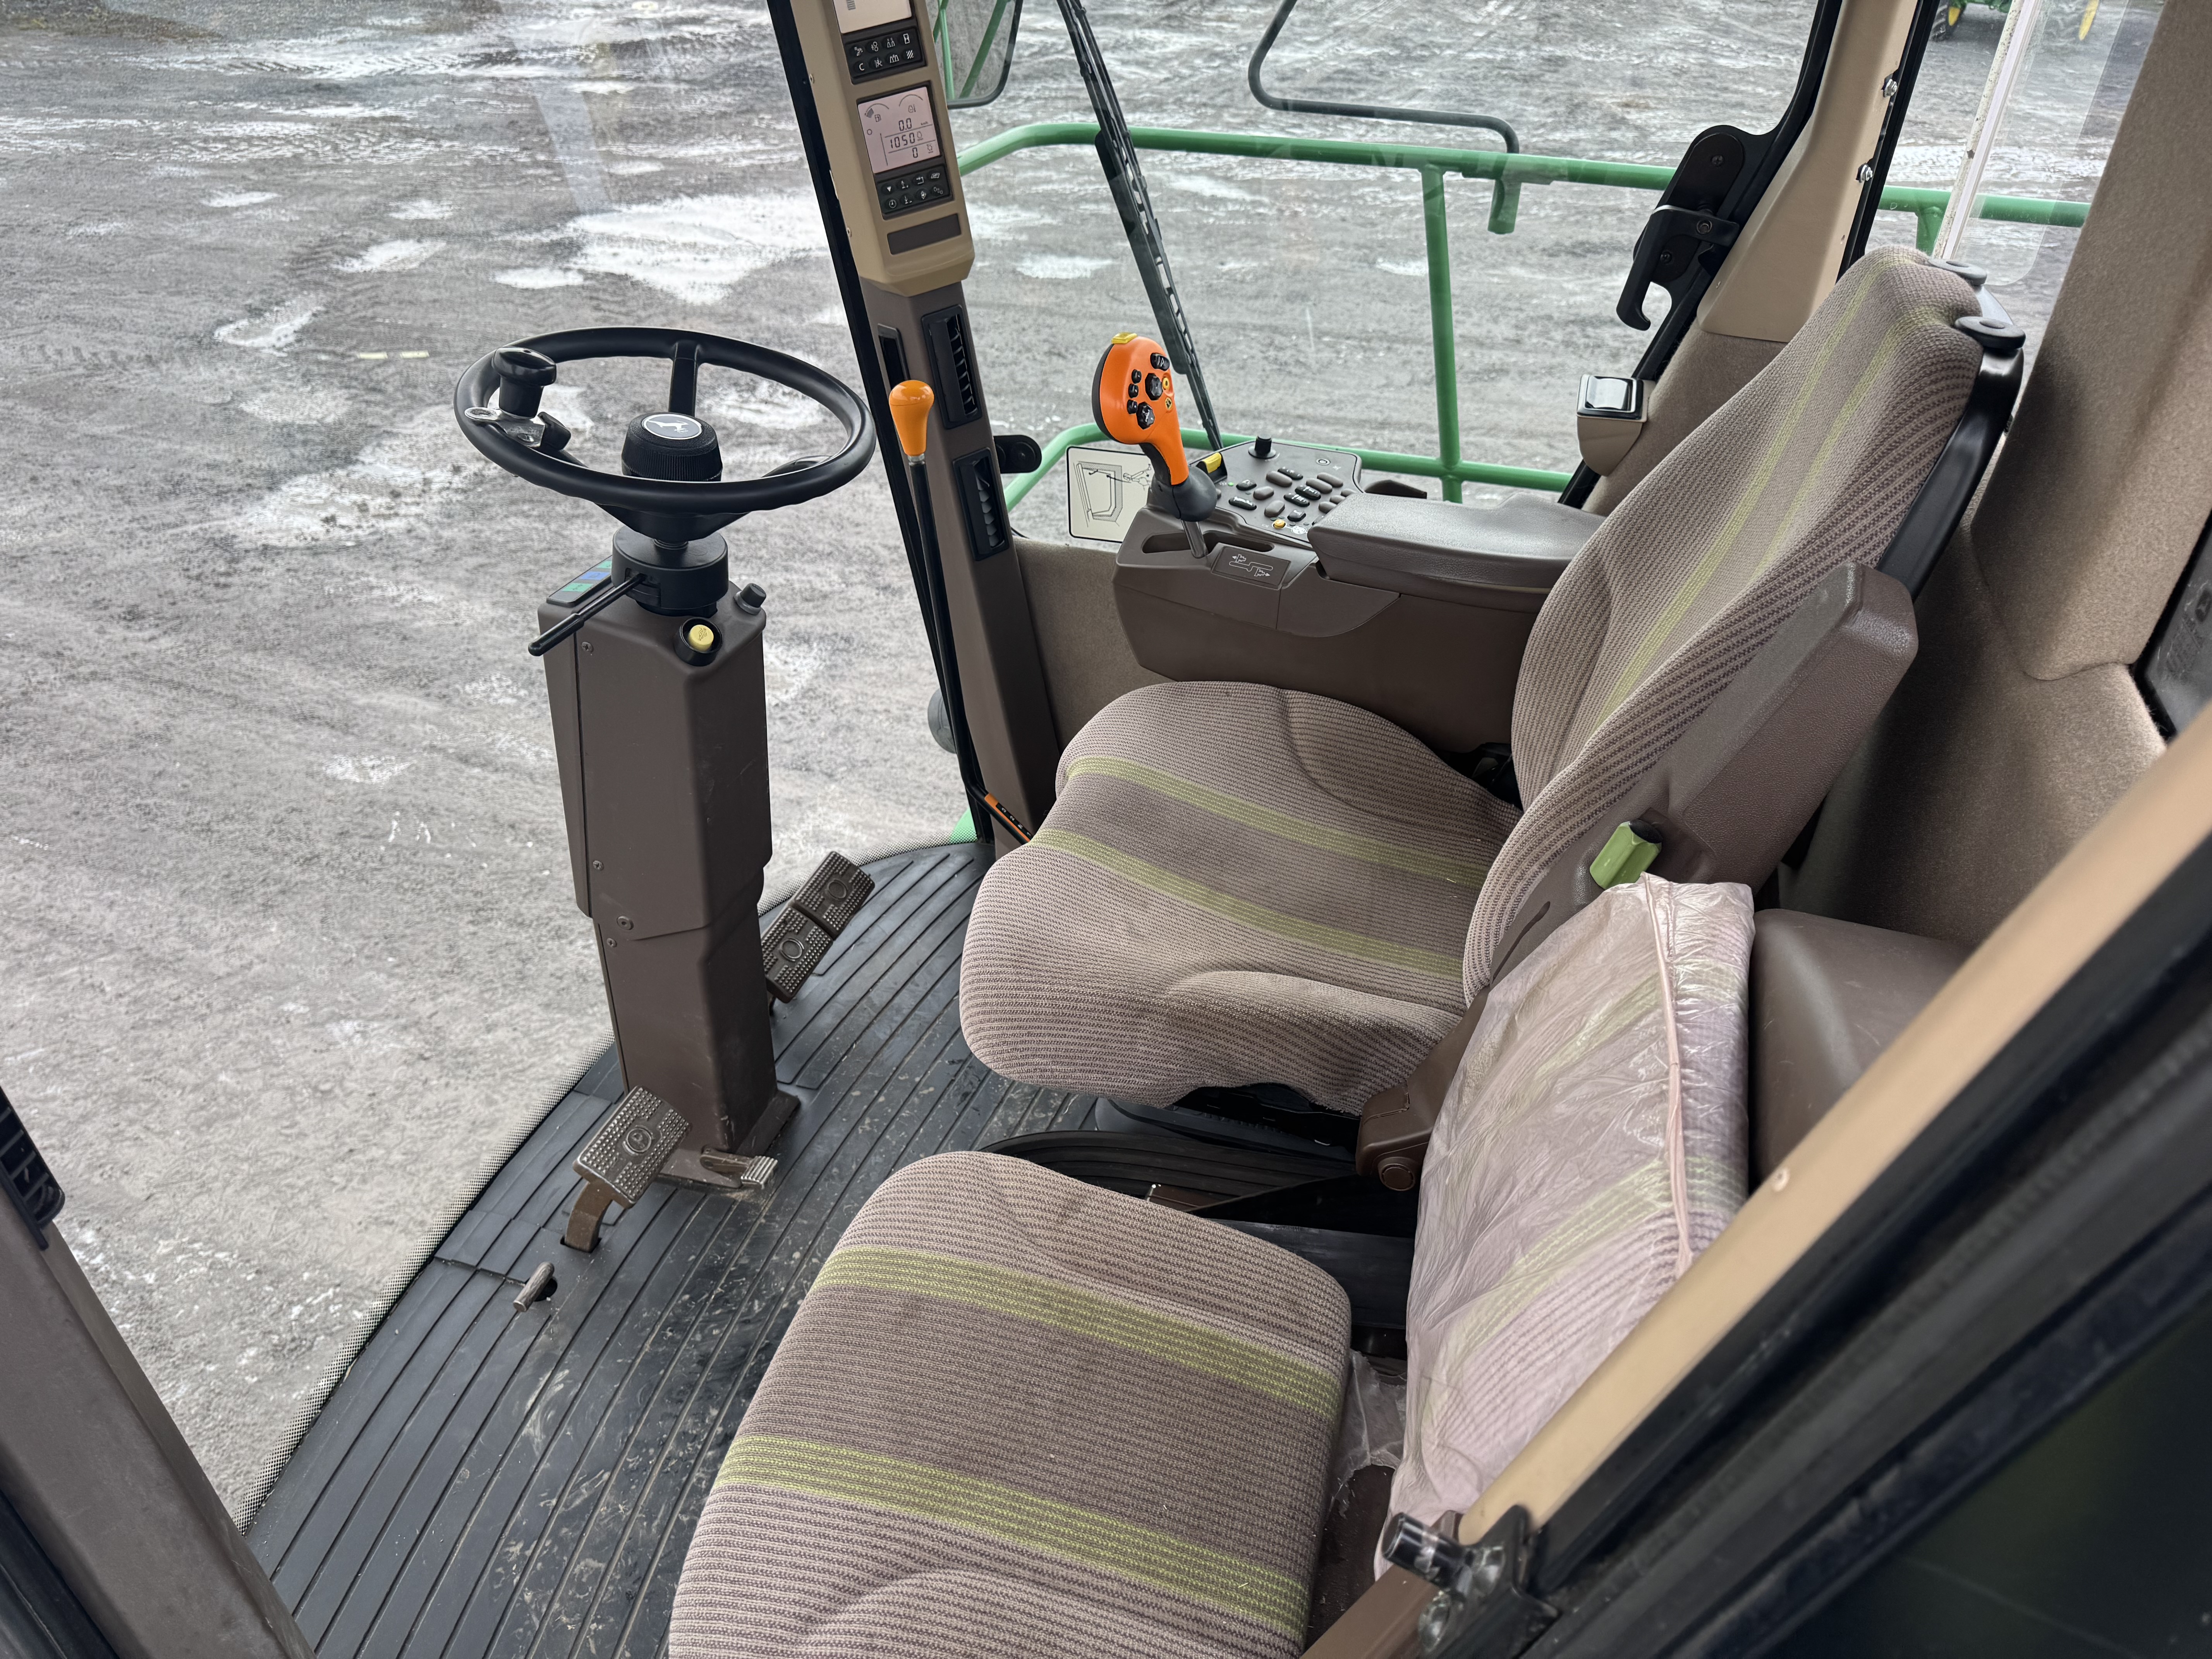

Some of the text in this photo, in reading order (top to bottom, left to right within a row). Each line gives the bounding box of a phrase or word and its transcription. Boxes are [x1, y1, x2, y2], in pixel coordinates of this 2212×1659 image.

[859, 63, 865, 71] C
[898, 118, 912, 131] 0.0
[890, 132, 915, 149] 1050
[912, 147, 918, 158] 0
